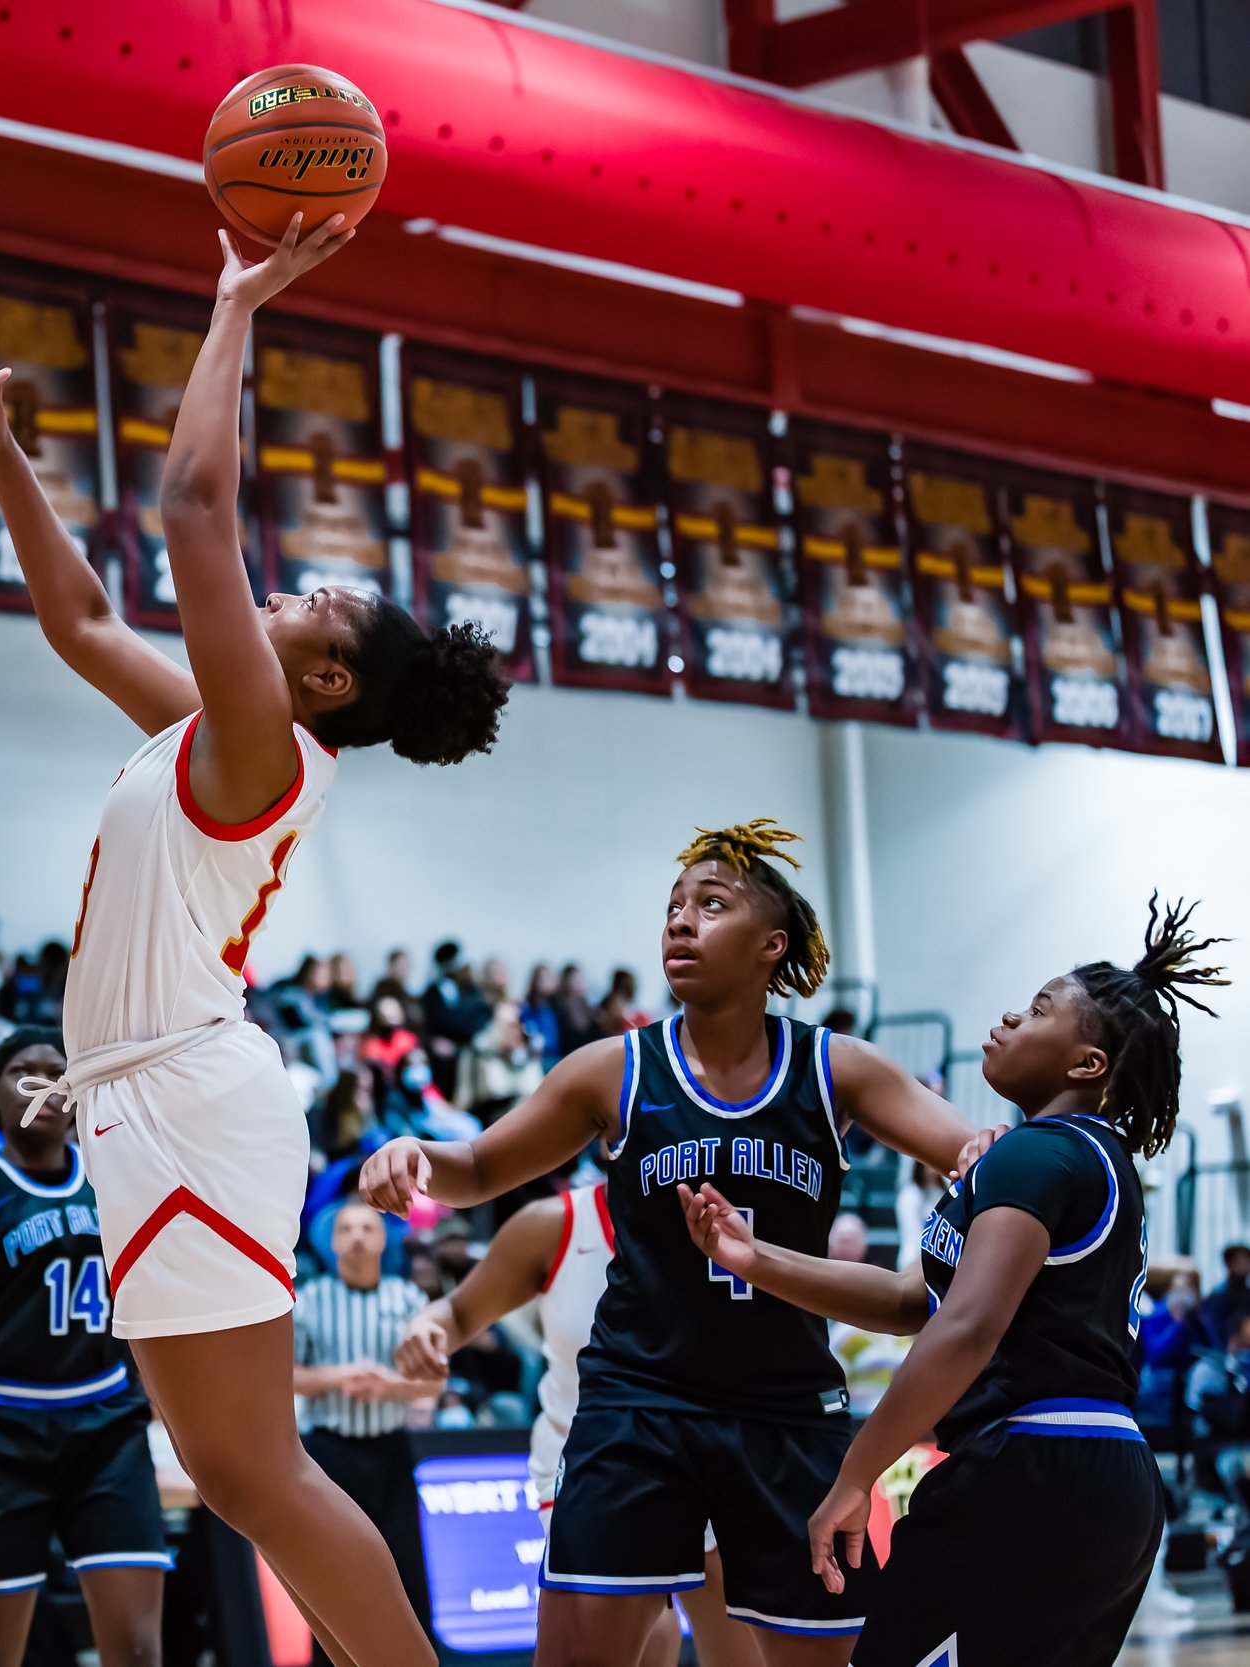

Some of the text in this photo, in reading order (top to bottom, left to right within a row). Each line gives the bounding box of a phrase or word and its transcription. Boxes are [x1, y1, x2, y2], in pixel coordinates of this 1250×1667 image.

[251, 87, 291, 115] PRO
[258, 146, 375, 181] Baden
[639, 1137, 823, 1202] PORT ALLEN
[2, 1208, 65, 1268] PORT
[43, 1255, 111, 1337] 14
